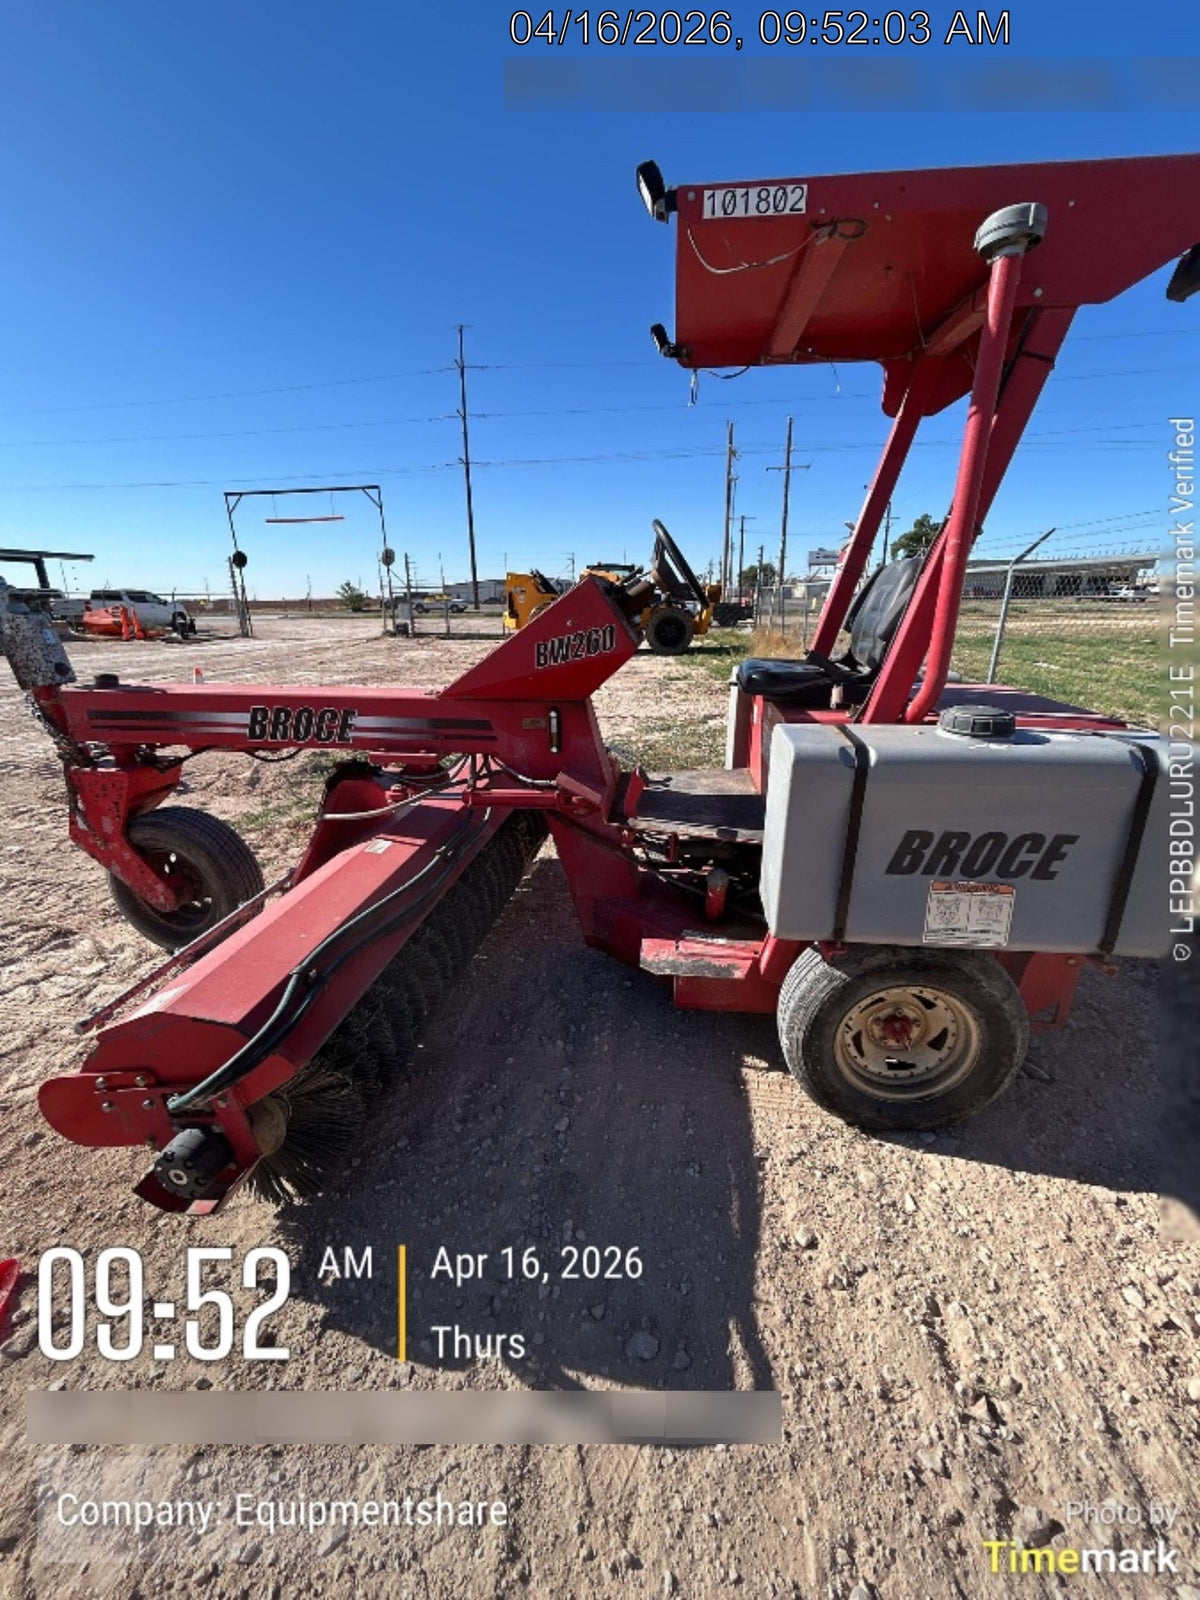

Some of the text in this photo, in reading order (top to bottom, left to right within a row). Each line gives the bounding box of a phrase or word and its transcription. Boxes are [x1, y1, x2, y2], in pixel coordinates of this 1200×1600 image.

[706, 185, 805, 216] 101802
[246, 705, 358, 743] BROCE
[885, 829, 1080, 881] BROCE
